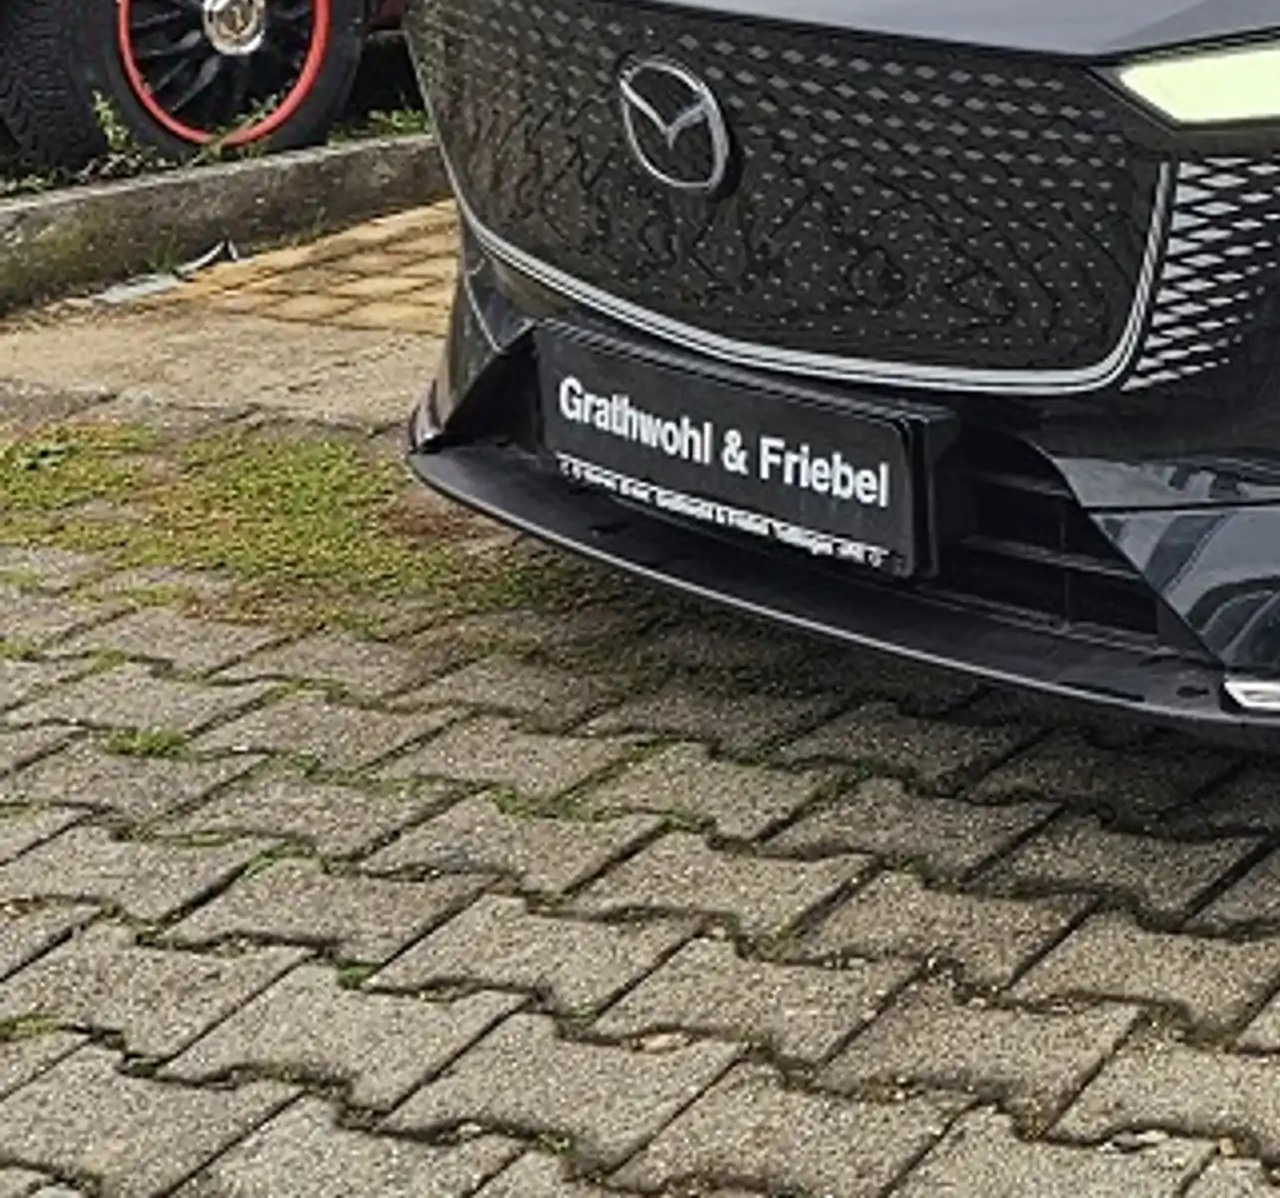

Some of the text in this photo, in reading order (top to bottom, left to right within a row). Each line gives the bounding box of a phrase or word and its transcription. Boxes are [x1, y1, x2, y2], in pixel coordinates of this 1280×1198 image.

[558, 375, 890, 508] Grathwohl & Friebel
